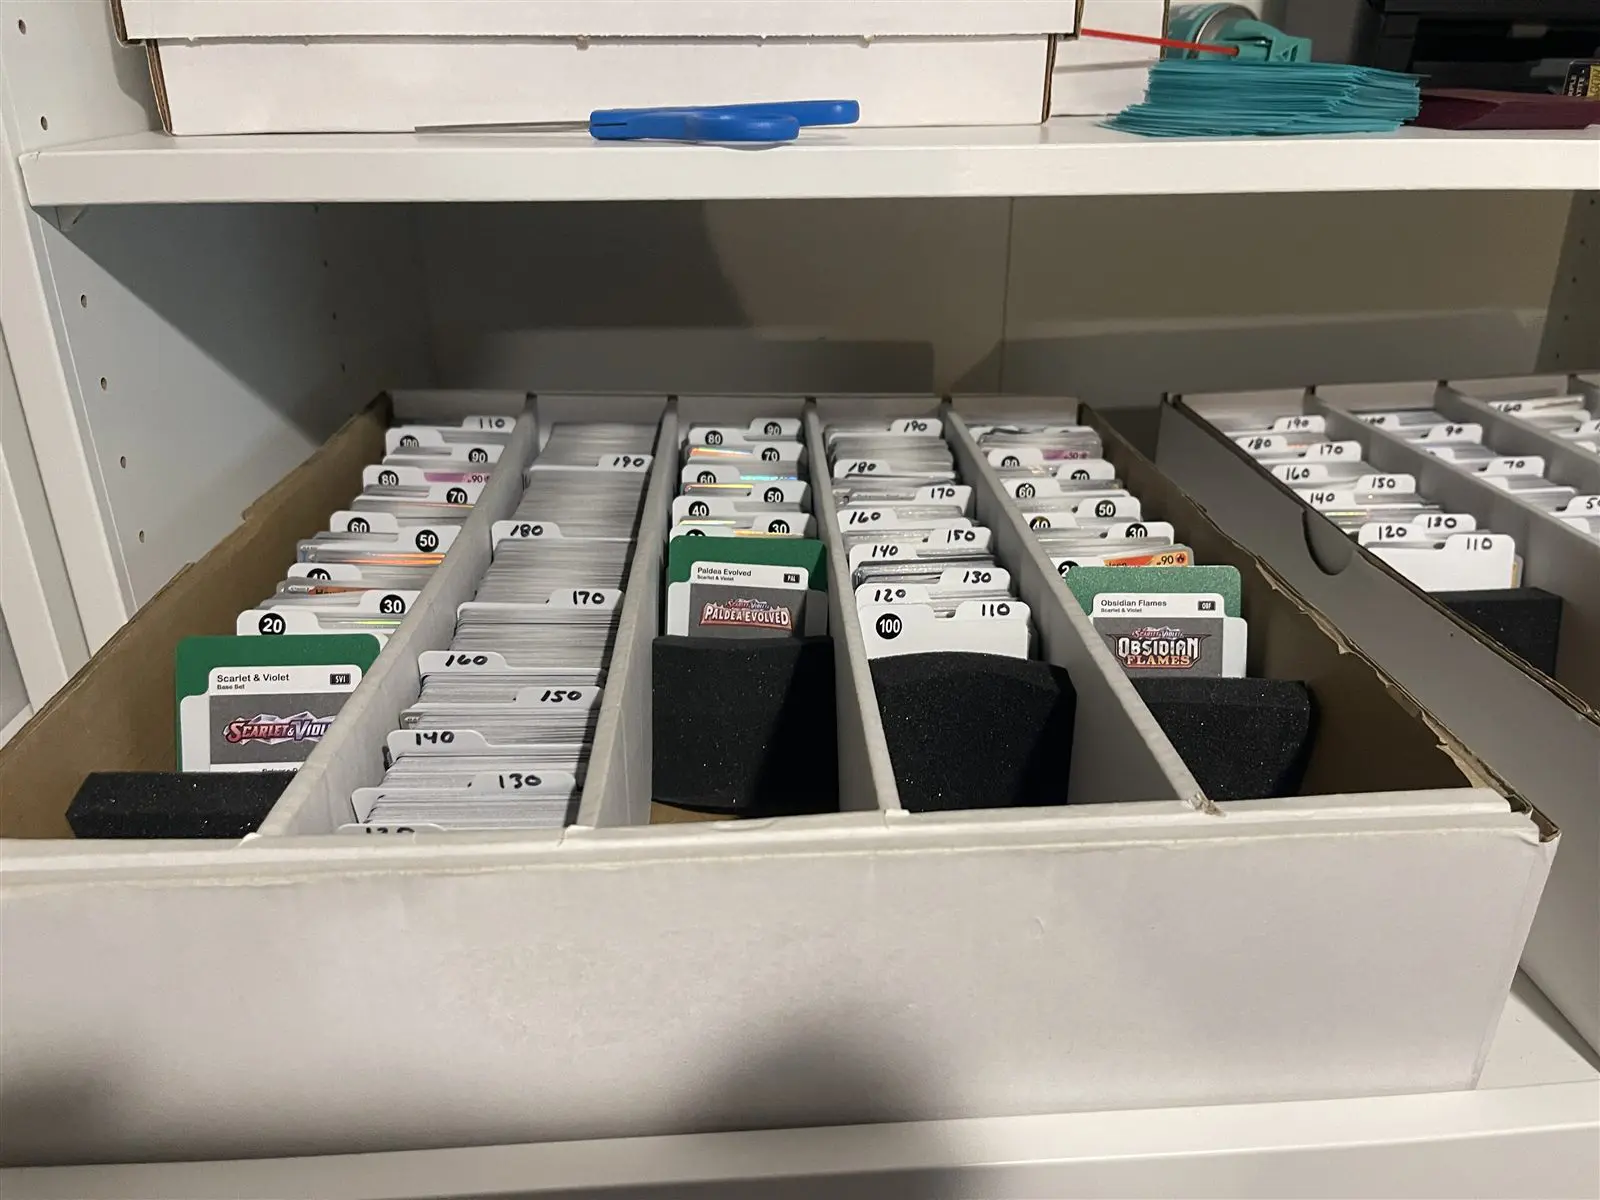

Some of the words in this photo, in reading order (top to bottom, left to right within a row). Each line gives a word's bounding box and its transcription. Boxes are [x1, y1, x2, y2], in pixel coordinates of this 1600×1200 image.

[479, 417, 506, 429] 110
[903, 420, 928, 433] 190
[1287, 419, 1310, 430] 190
[767, 425, 779, 435] 90
[1445, 425, 1463, 437] 90
[707, 433, 721, 445] 80
[1248, 439, 1272, 450] 180
[765, 451, 778, 461] 70
[1319, 444, 1344, 456] 170
[471, 452, 487, 462] 90
[613, 455, 645, 467] 190
[848, 462, 877, 473] 180
[1503, 459, 1525, 469] 70
[381, 473, 397, 485] 80
[700, 475, 714, 484] 60
[1286, 467, 1310, 481] 160
[1372, 477, 1396, 489] 150
[450, 491, 465, 503] 70
[767, 491, 782, 502] 50
[930, 488, 956, 499] 170
[1019, 486, 1033, 498] 60
[1310, 492, 1335, 504] 140
[1586, 497, 1600, 510] 5
[691, 505, 707, 516] 40
[1099, 504, 1114, 516] 50
[849, 511, 881, 524] 160
[351, 521, 367, 532] 60
[510, 524, 544, 537] 180
[772, 525, 787, 534] 30
[1129, 527, 1144, 537] 30
[1378, 525, 1407, 540] 120
[420, 534, 436, 547] 50
[947, 529, 976, 543] 150
[1466, 537, 1493, 550] 110
[872, 544, 898, 558] 140
[697, 566, 722, 575] Paldea
[723, 568, 752, 577] Evolved
[963, 571, 992, 584] 130
[573, 591, 605, 605] 170
[874, 588, 907, 602] 120
[384, 600, 403, 613] 30
[1100, 599, 1137, 607] Obsidian
[1138, 599, 1167, 607] Flames
[704, 605, 742, 621] PALDEA
[745, 611, 789, 625] EVOLVED
[981, 603, 1010, 617] 110
[262, 619, 283, 633] 20
[879, 619, 901, 633] 100
[1118, 637, 1199, 659] OBSIDIAN
[445, 654, 488, 667] 160
[1127, 655, 1190, 665] FLAMES
[217, 674, 251, 683] Scarlet
[253, 674, 261, 682] &
[262, 673, 290, 682] Violet
[540, 690, 582, 702] 150
[225, 721, 290, 743] SCARLET
[415, 731, 455, 745] 140
[499, 774, 541, 789] 130
